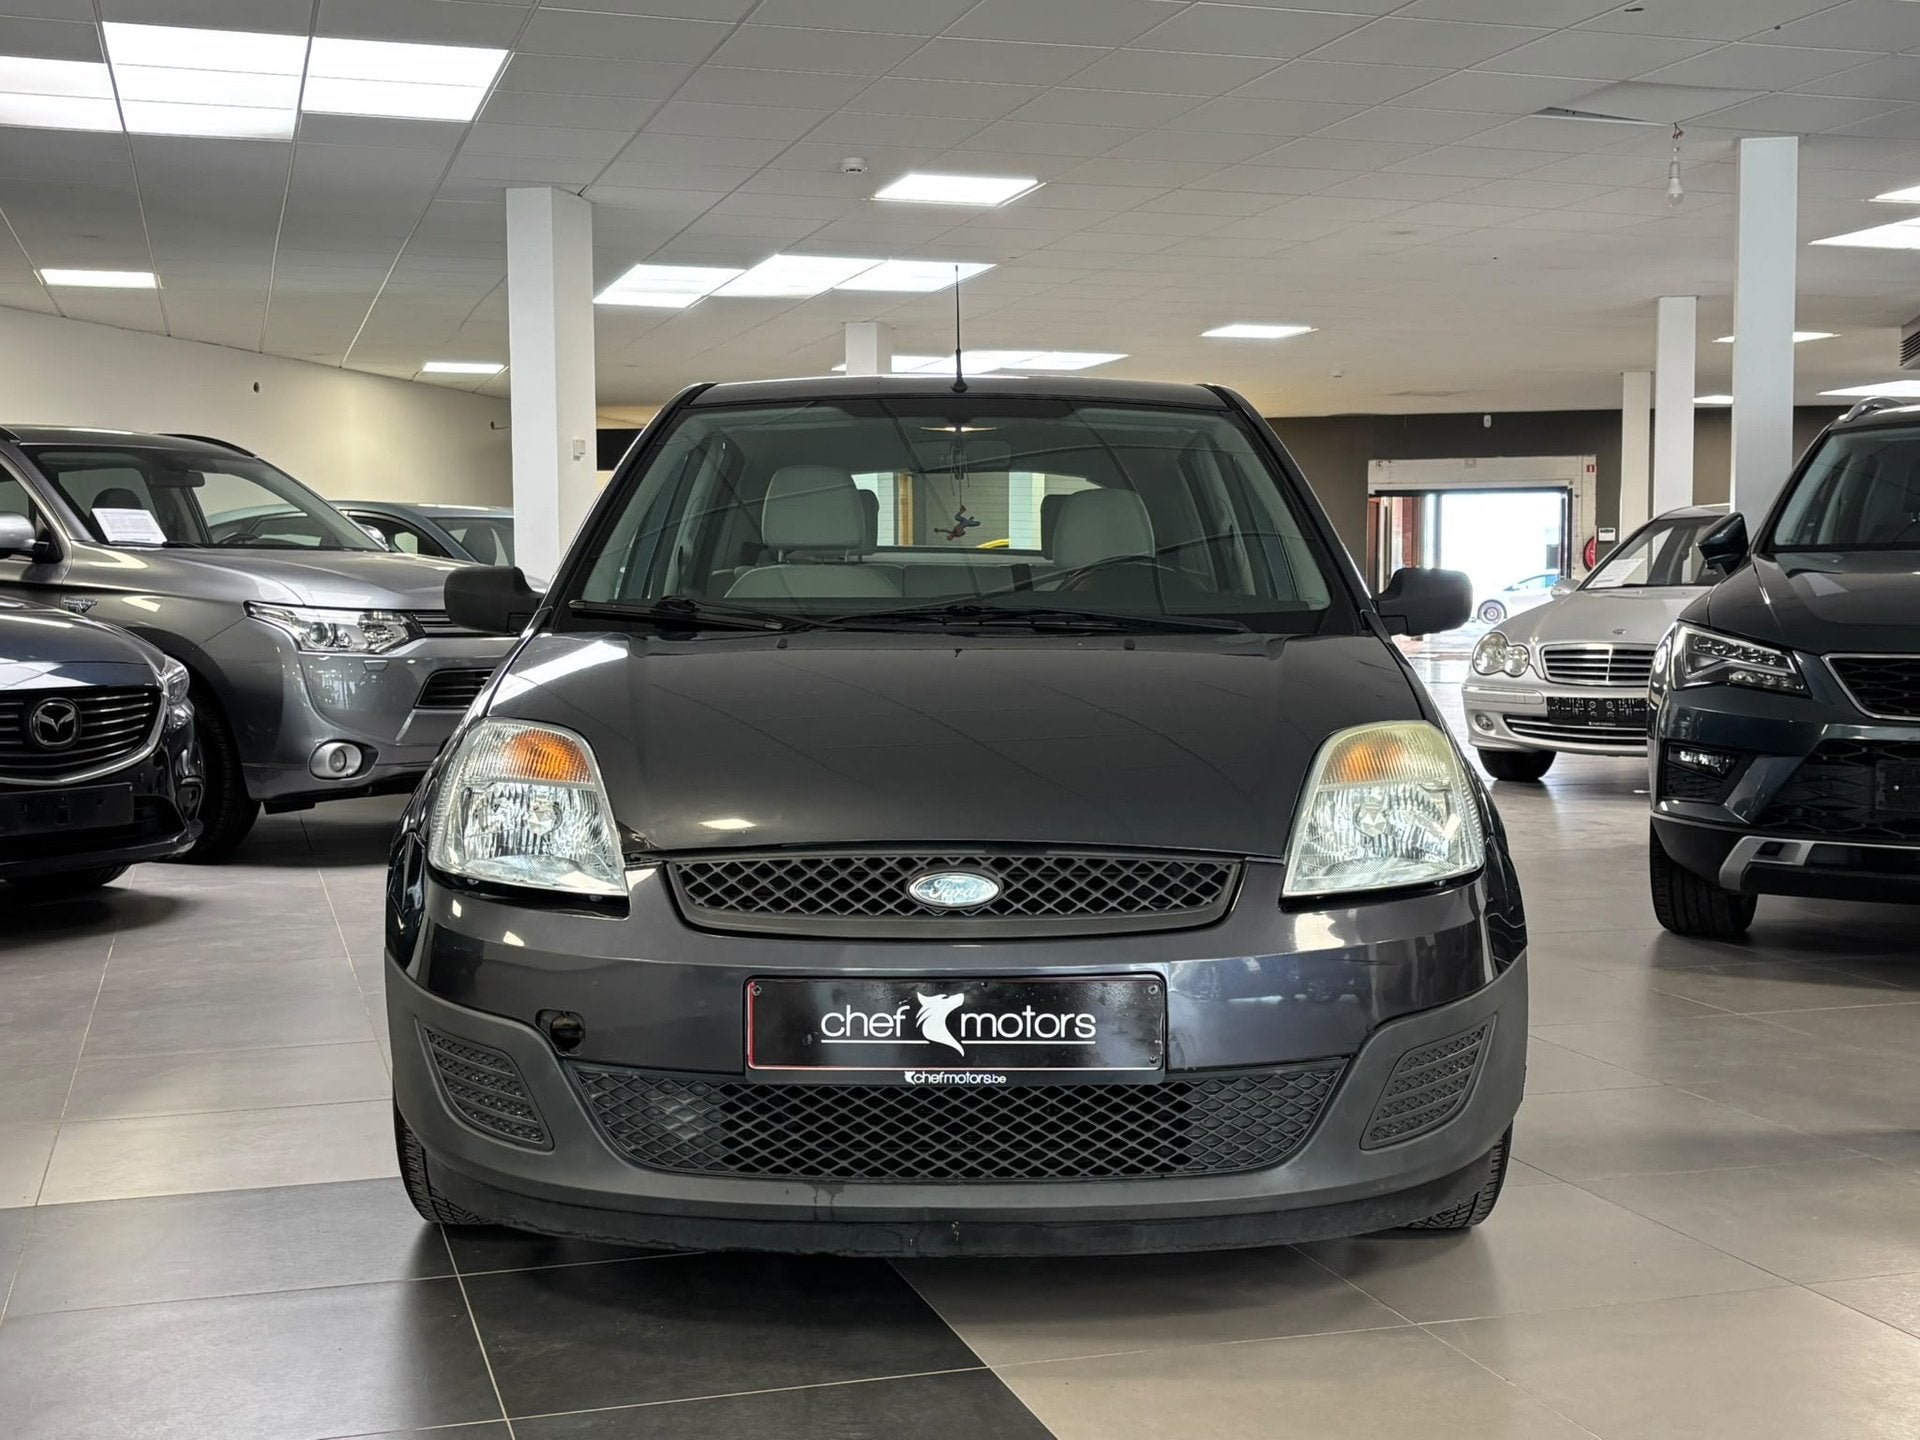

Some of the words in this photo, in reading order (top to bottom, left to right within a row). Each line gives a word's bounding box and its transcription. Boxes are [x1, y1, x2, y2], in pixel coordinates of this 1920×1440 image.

[928, 879, 977, 902] Ford
[820, 1004, 911, 1037] chef
[960, 1004, 1097, 1038] motors
[913, 1071, 1007, 1084] chefmotors.be
